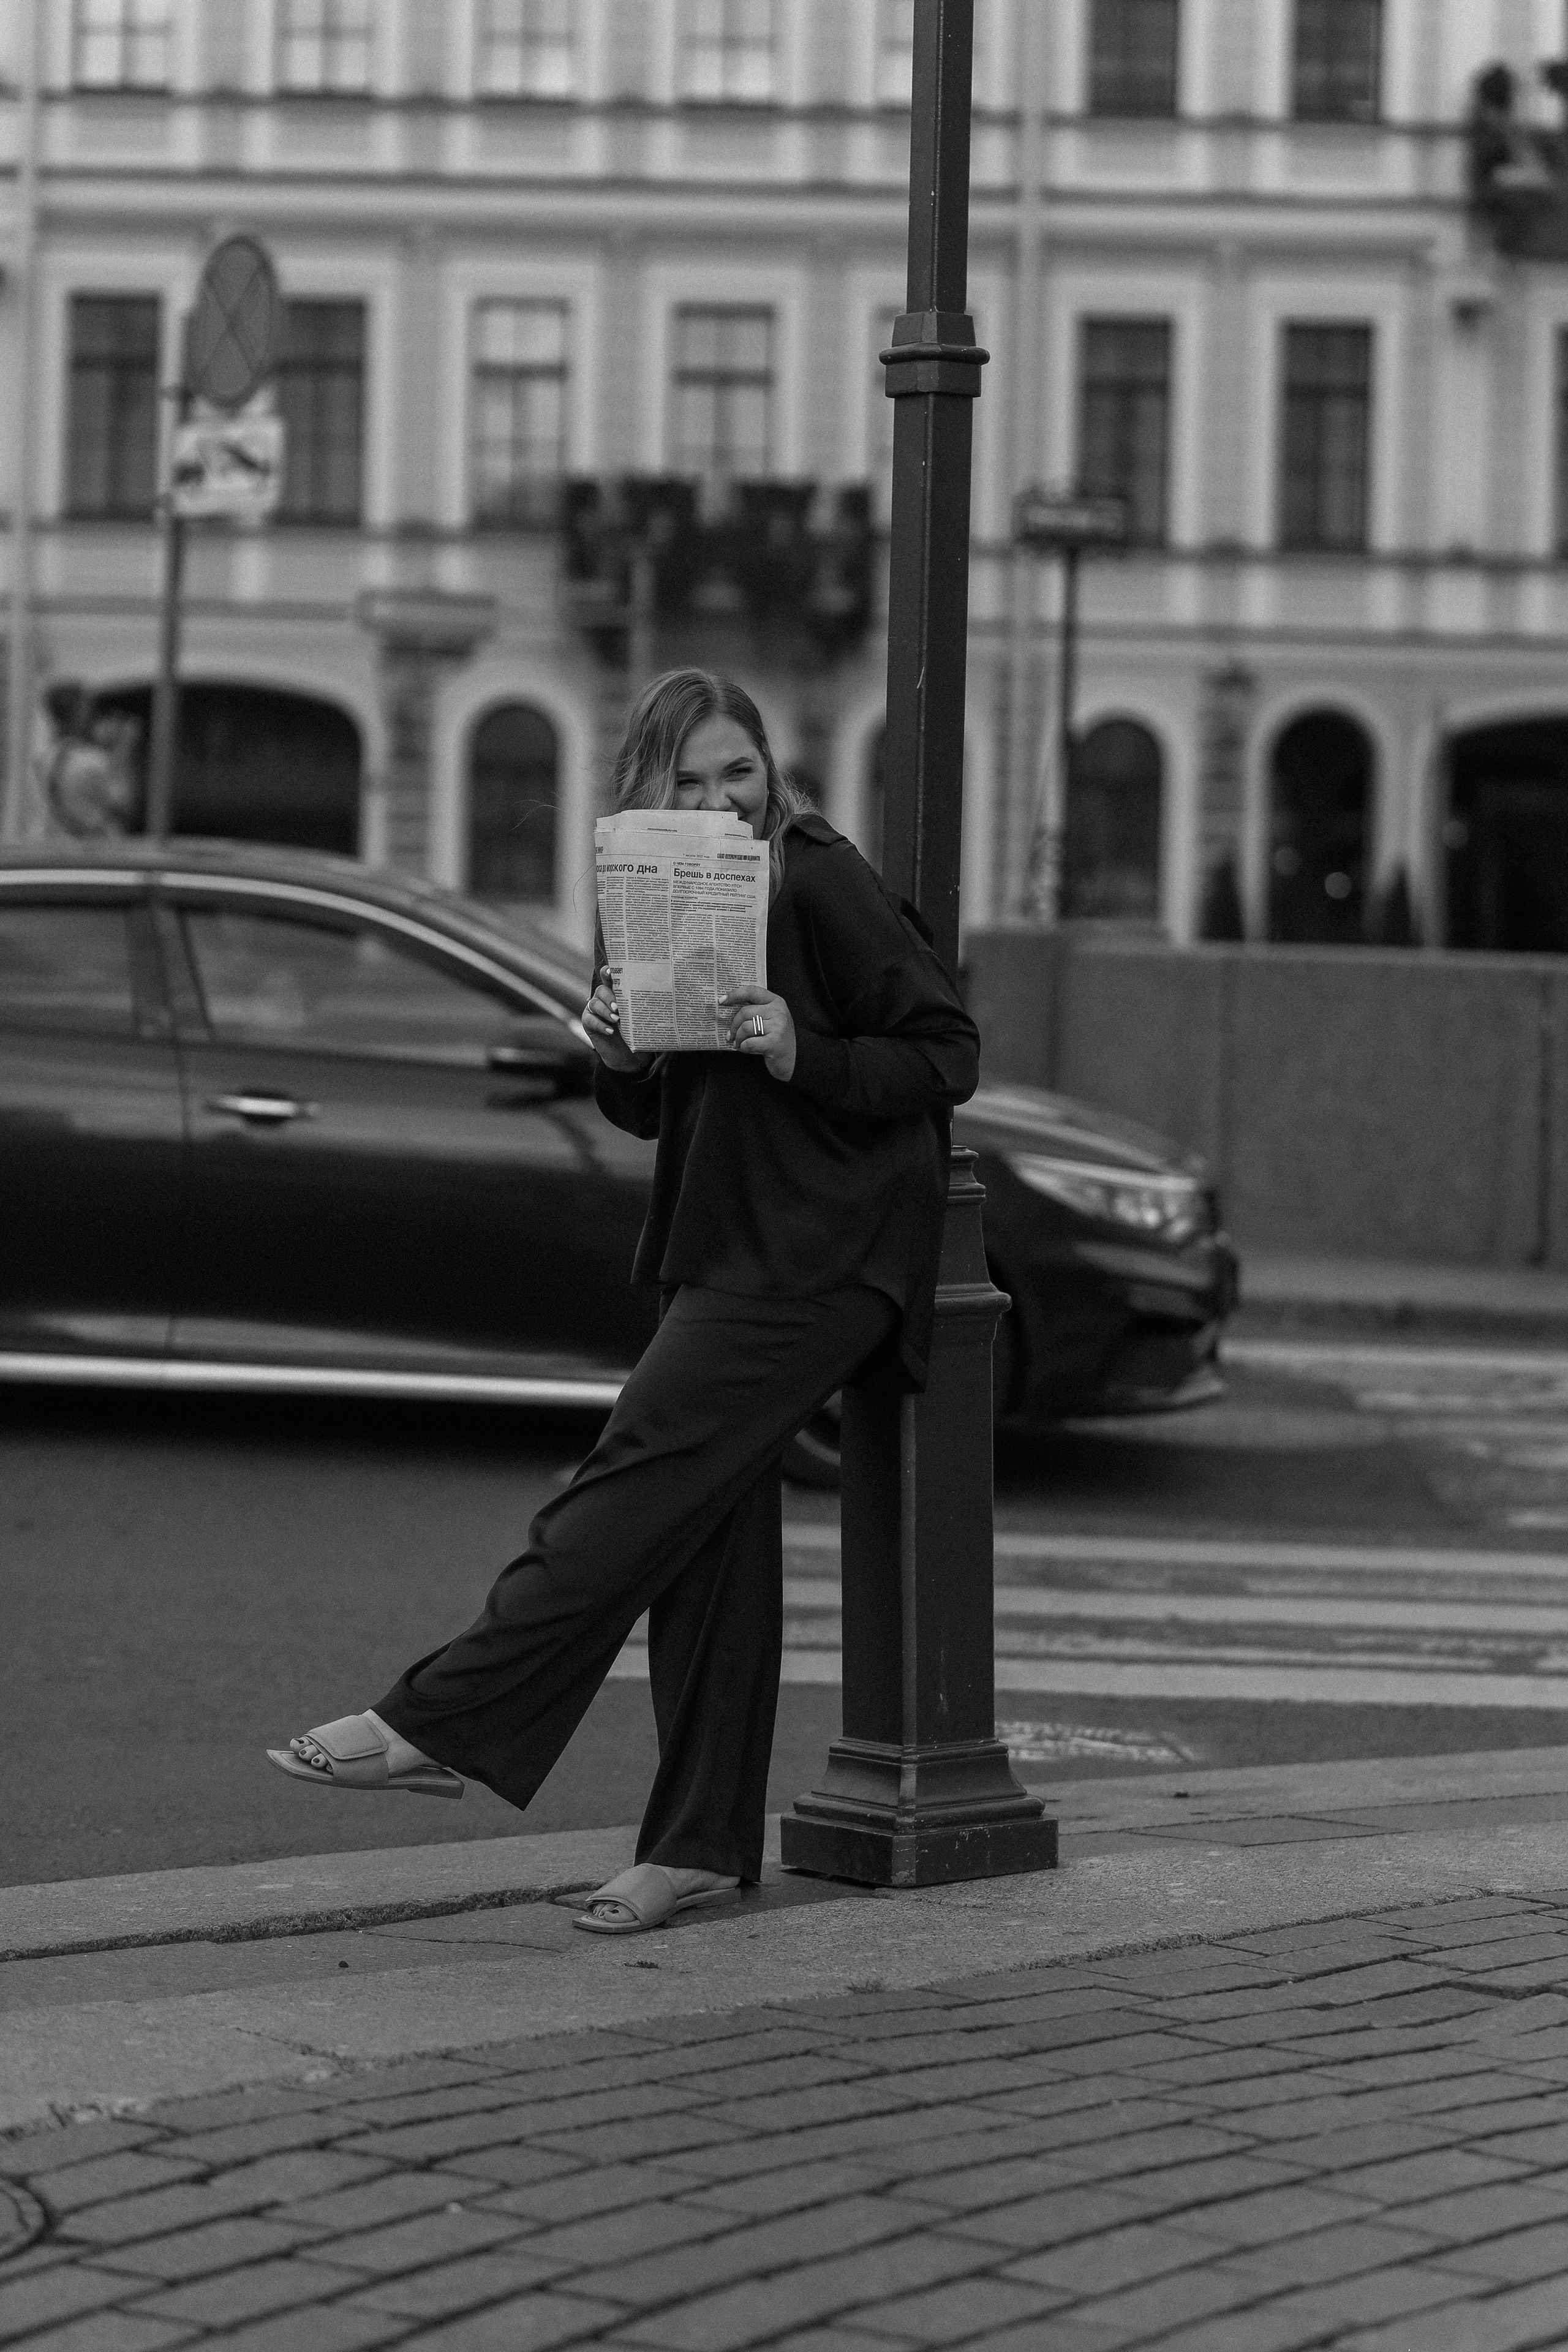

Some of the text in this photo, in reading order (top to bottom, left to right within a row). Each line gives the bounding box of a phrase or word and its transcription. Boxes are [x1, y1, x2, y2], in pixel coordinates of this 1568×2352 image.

[606, 864, 634, 874] морского
[636, 864, 658, 875] дна
[674, 868, 704, 879] Брешь
[714, 873, 756, 882] доспехах
